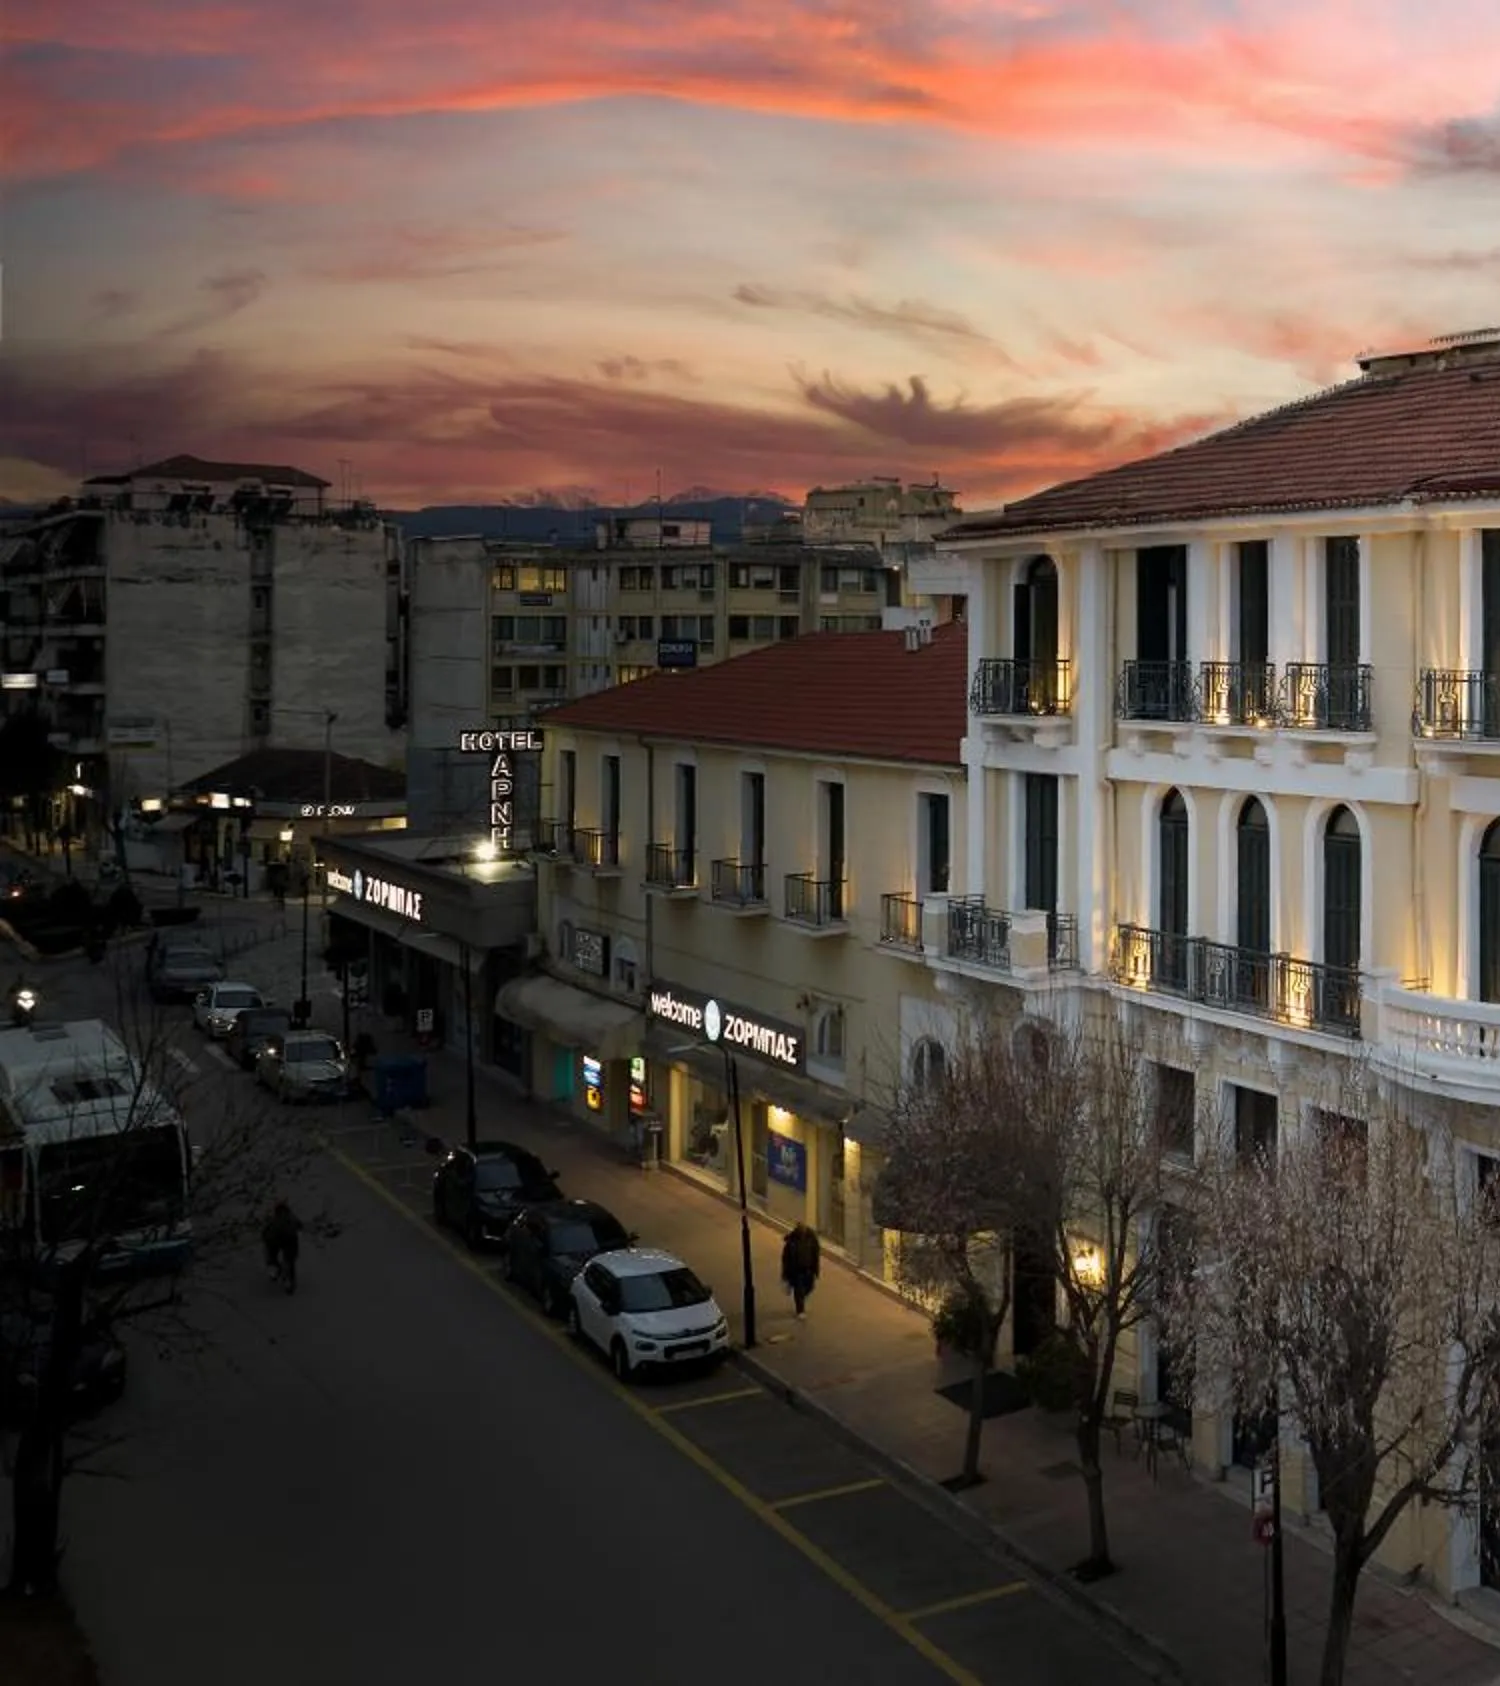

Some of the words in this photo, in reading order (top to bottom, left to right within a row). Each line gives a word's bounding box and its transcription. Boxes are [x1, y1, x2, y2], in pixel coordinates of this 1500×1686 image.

[461, 731, 543, 751] HOTEL
[365, 876, 422, 920] ΖΟΡΜΠΑΣ
[651, 991, 702, 1029] welcome
[724, 1014, 797, 1065] ΖΟΡΜΠΑΣ
